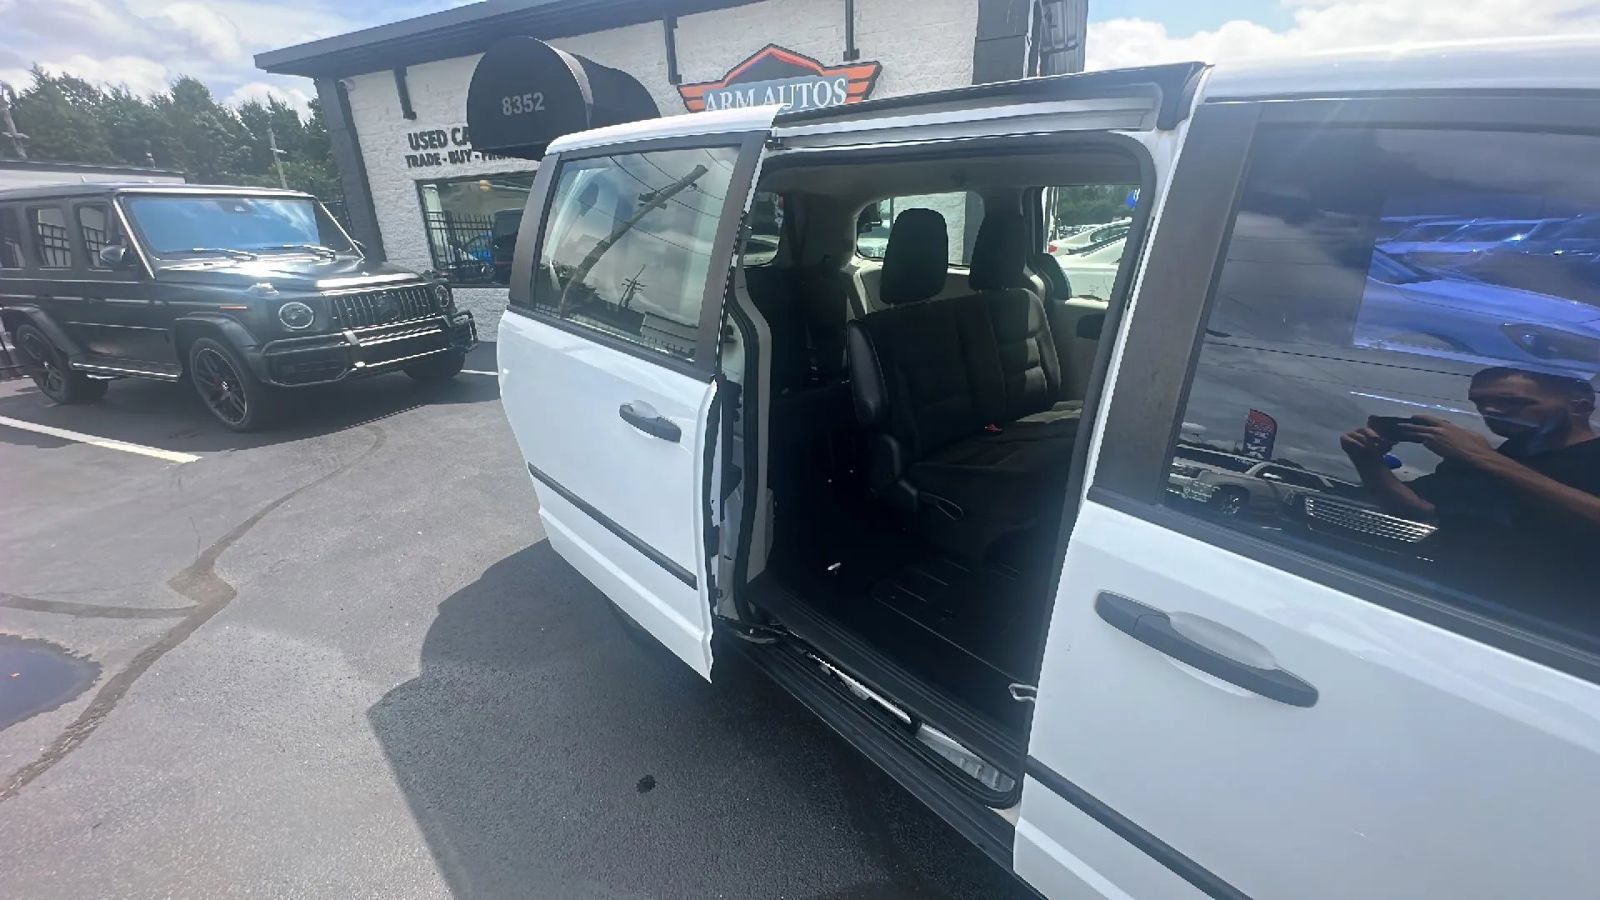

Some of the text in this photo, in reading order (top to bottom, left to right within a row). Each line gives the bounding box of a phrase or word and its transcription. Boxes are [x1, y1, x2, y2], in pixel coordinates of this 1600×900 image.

[502, 92, 545, 115] 8352
[705, 78, 847, 111] ARM AUTOS
[408, 126, 471, 151] USED CA
[405, 153, 442, 169] TRADE
[448, 149, 472, 164] BUY
